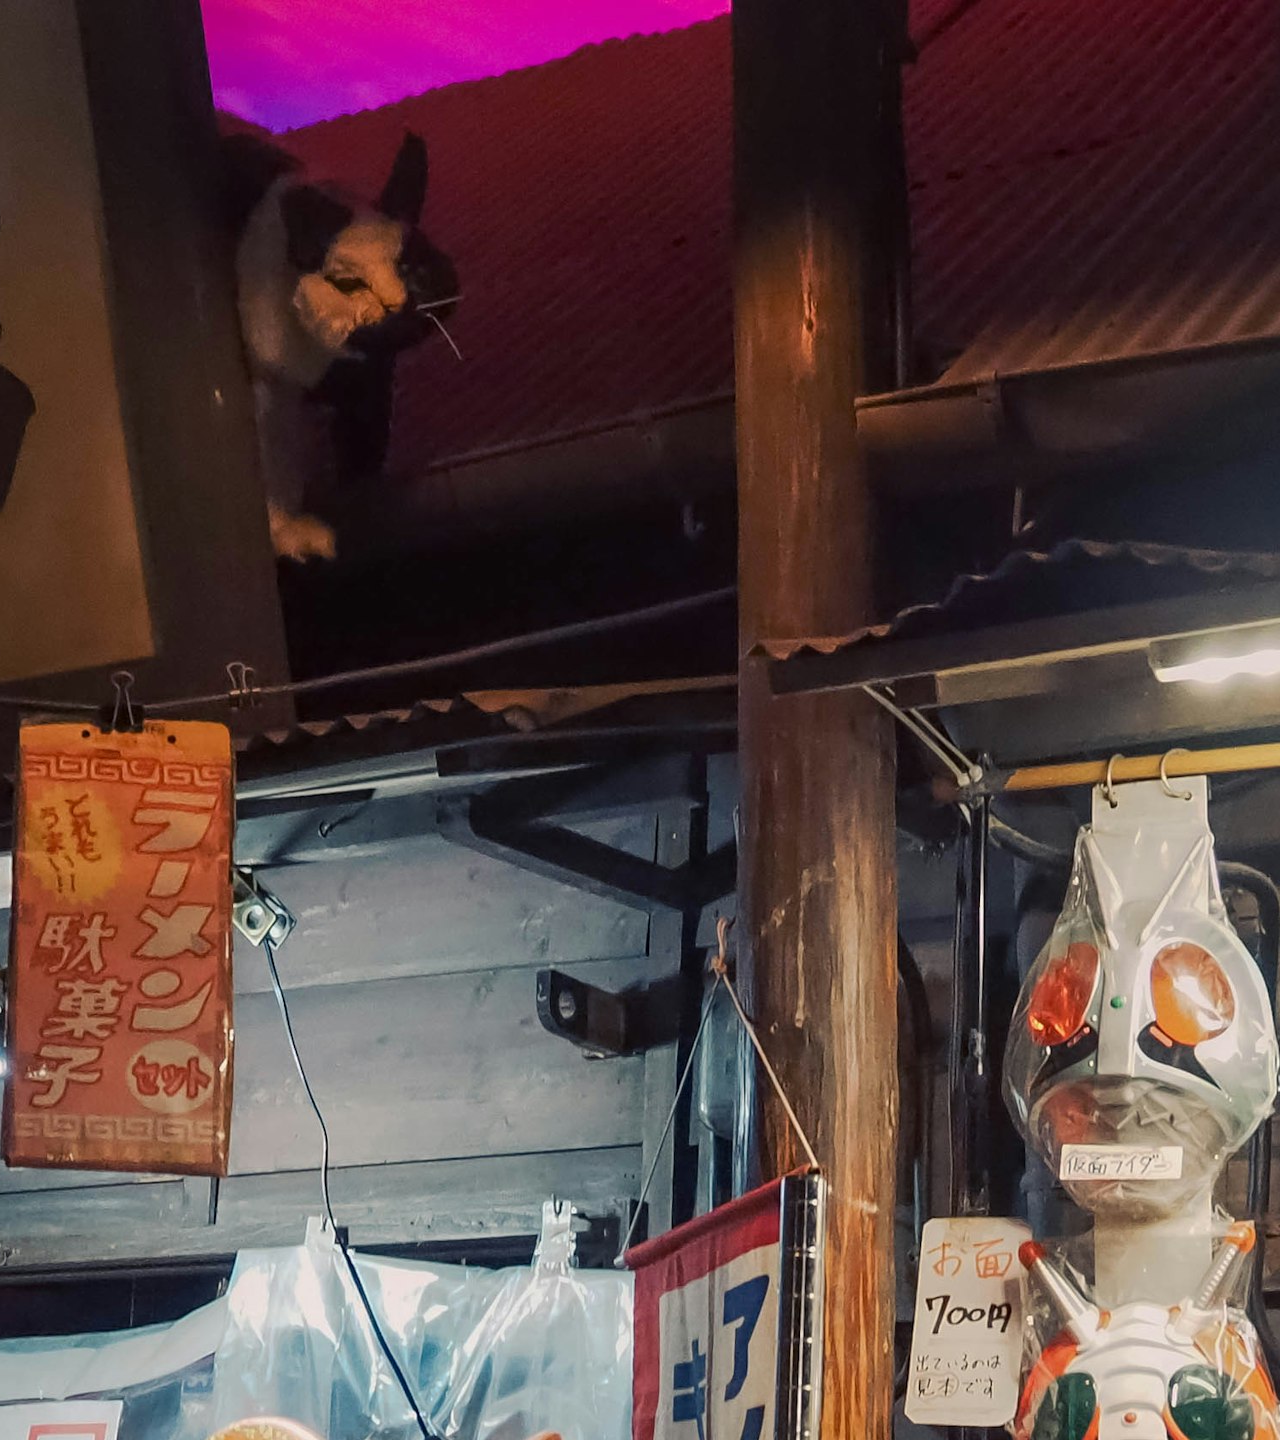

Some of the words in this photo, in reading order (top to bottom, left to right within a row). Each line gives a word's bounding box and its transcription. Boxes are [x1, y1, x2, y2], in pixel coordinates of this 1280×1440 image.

[129, 789, 220, 1034] ラーメン
[24, 912, 133, 1109] 駄菓子
[132, 1055, 213, 1099] セット
[1066, 1150, 1169, 1176] 仮面ライダー
[927, 1238, 1014, 1279] お面
[925, 1295, 1012, 1335] 700円
